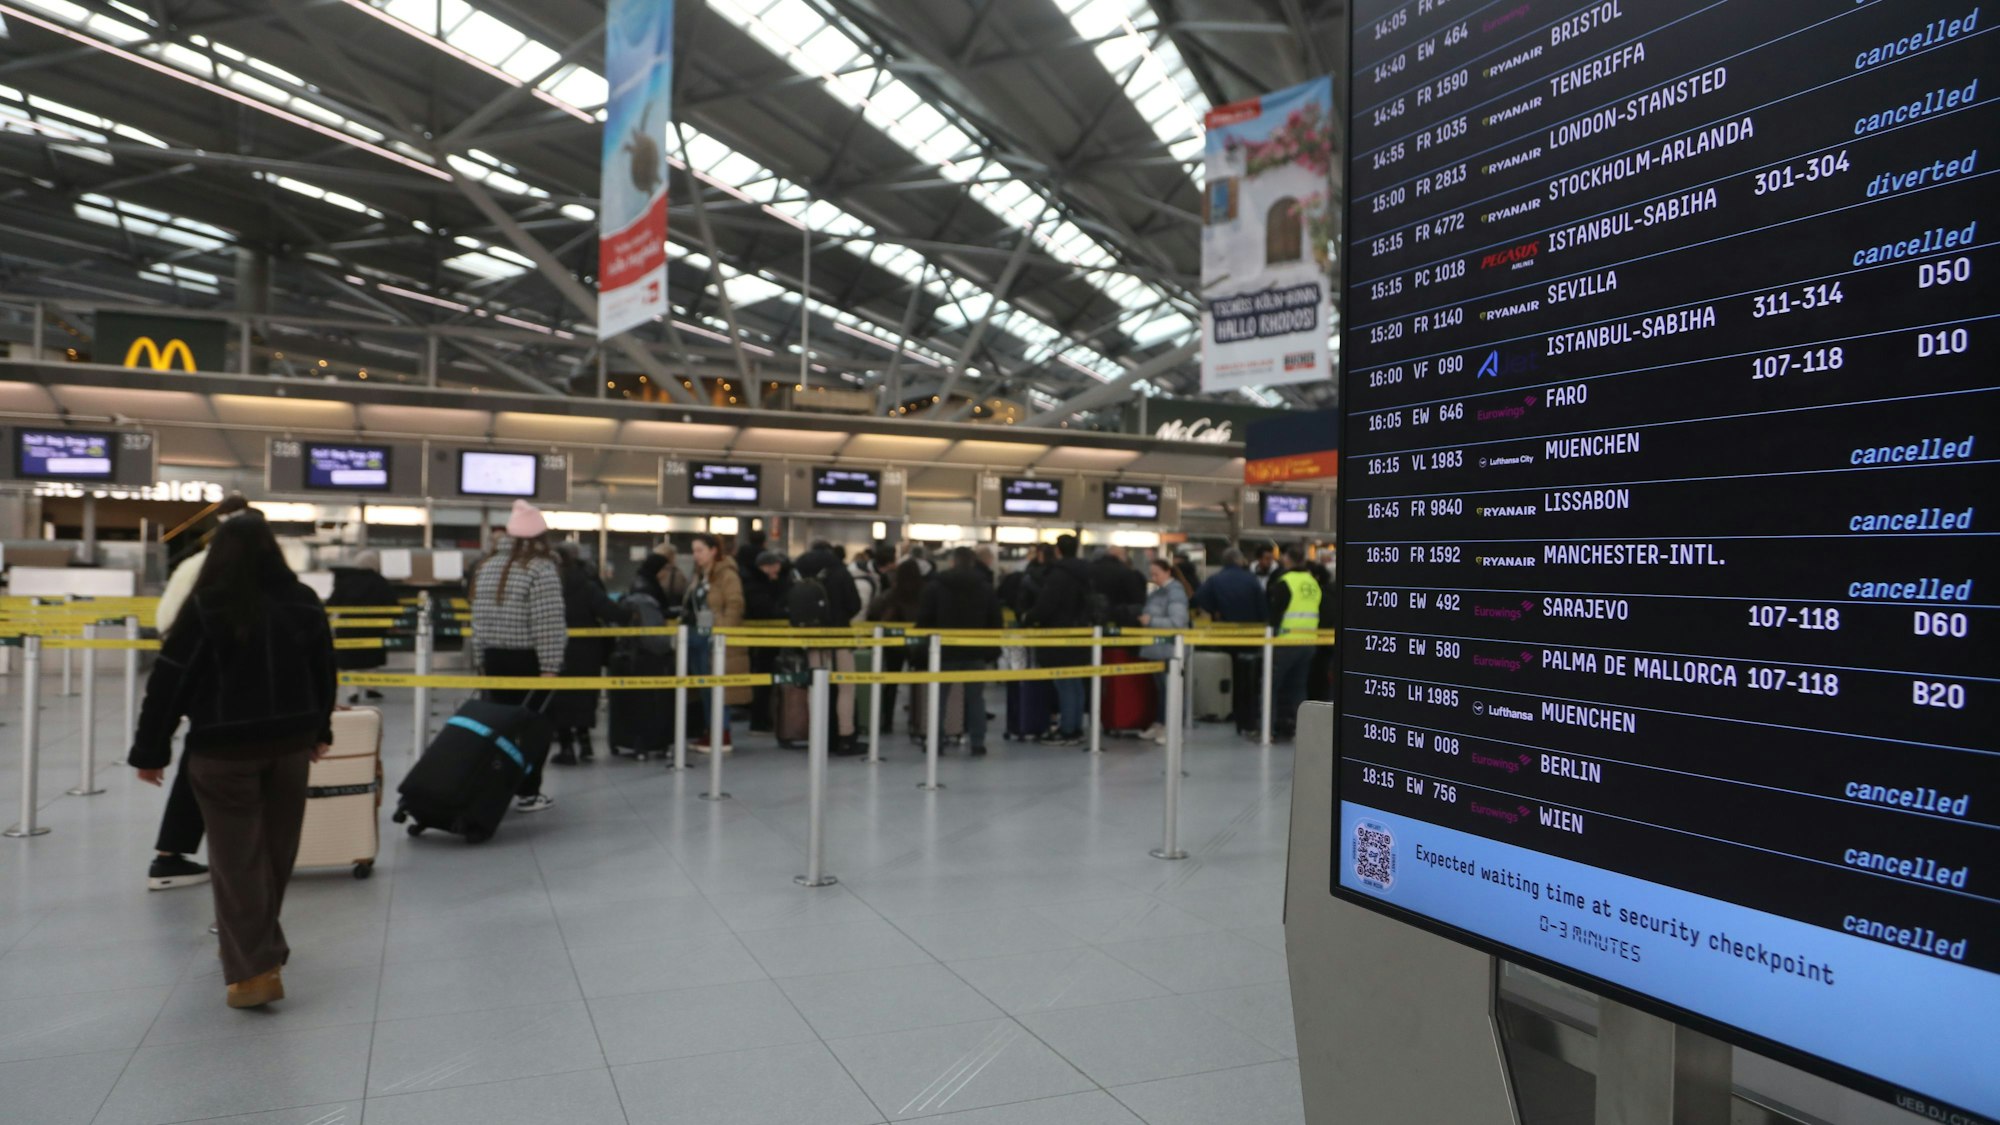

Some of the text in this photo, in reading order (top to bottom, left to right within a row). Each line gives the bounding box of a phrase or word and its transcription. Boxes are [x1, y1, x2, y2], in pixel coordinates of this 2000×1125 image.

[1374, 8, 1406, 40] 14:05
[1374, 54, 1406, 83] 14:40
[1418, 38, 1435, 61] EW
[1444, 22, 1468, 46] 464
[1374, 0, 1622, 126] 14:45 FR 1590 RYANAIR BRISTOL
[1372, 7, 1979, 213] 15:00 FR 2813 RYANAIR LONDON-STANSTED cancelled
[1373, 42, 1645, 170] 14:55 FR 1035 RYANAIR TENERIFFA
[1371, 150, 1978, 300] 15:15 PC 1018 PEGASUS ISTANBUL-SABIHA 301-304 diverted
[1372, 79, 1978, 257] 15:15 FR 4772 RYANAIR STOCKHOLM-ARLANDA cancelled
[1370, 221, 1976, 344] 15:20 FR 1140 RYANAIR SEVILLA cancelled
[1370, 366, 1403, 388] 16:00
[1413, 361, 1428, 380] VF
[1438, 354, 1464, 376] 090
[1546, 306, 1716, 356] ISTANBUL-SABIHA
[1752, 281, 1844, 318] 311-314
[1918, 257, 1971, 288] D50
[1511, 259, 1534, 271] AIRLINES
[1368, 328, 1968, 431] 16:05 EW 646 Eurowings FARO 107-118 D10
[1367, 488, 1974, 532] 16:45 FR 9840 RYANAIR LISSABON cancelled
[1368, 432, 1974, 476] 16:15 VL 1983 Lufthansa City MUENCHEN cancelled
[1366, 544, 1972, 601] 16:50 FR 1592 RYANAIR MANCHESTER-INTL. cancelled
[1366, 591, 1968, 638] 17:00 EW 492 Eurowings SARAJEVO 107-118 D60
[1364, 635, 1965, 710] 17:25 EW 580 Eurowings PALMA DE MALLORCA 107-118 B20
[1364, 679, 1968, 816] 17:55 LH 1985 Lufthansa MUENCHEN cancelled
[1364, 723, 1968, 888] 18:05 EW 008 Eurowings BERLIN cancelled
[1363, 766, 1967, 960] 18:15 EW 756 Eurowings WIEN cancelled
[1416, 844, 1476, 877] Expected
[1481, 868, 1540, 900] waiting
[1546, 883, 1586, 910] time
[1592, 898, 1612, 918] at
[1619, 906, 1700, 948] security
[1709, 931, 1835, 986] checkpoint
[1540, 914, 1641, 963] 0-3 MINUTES
